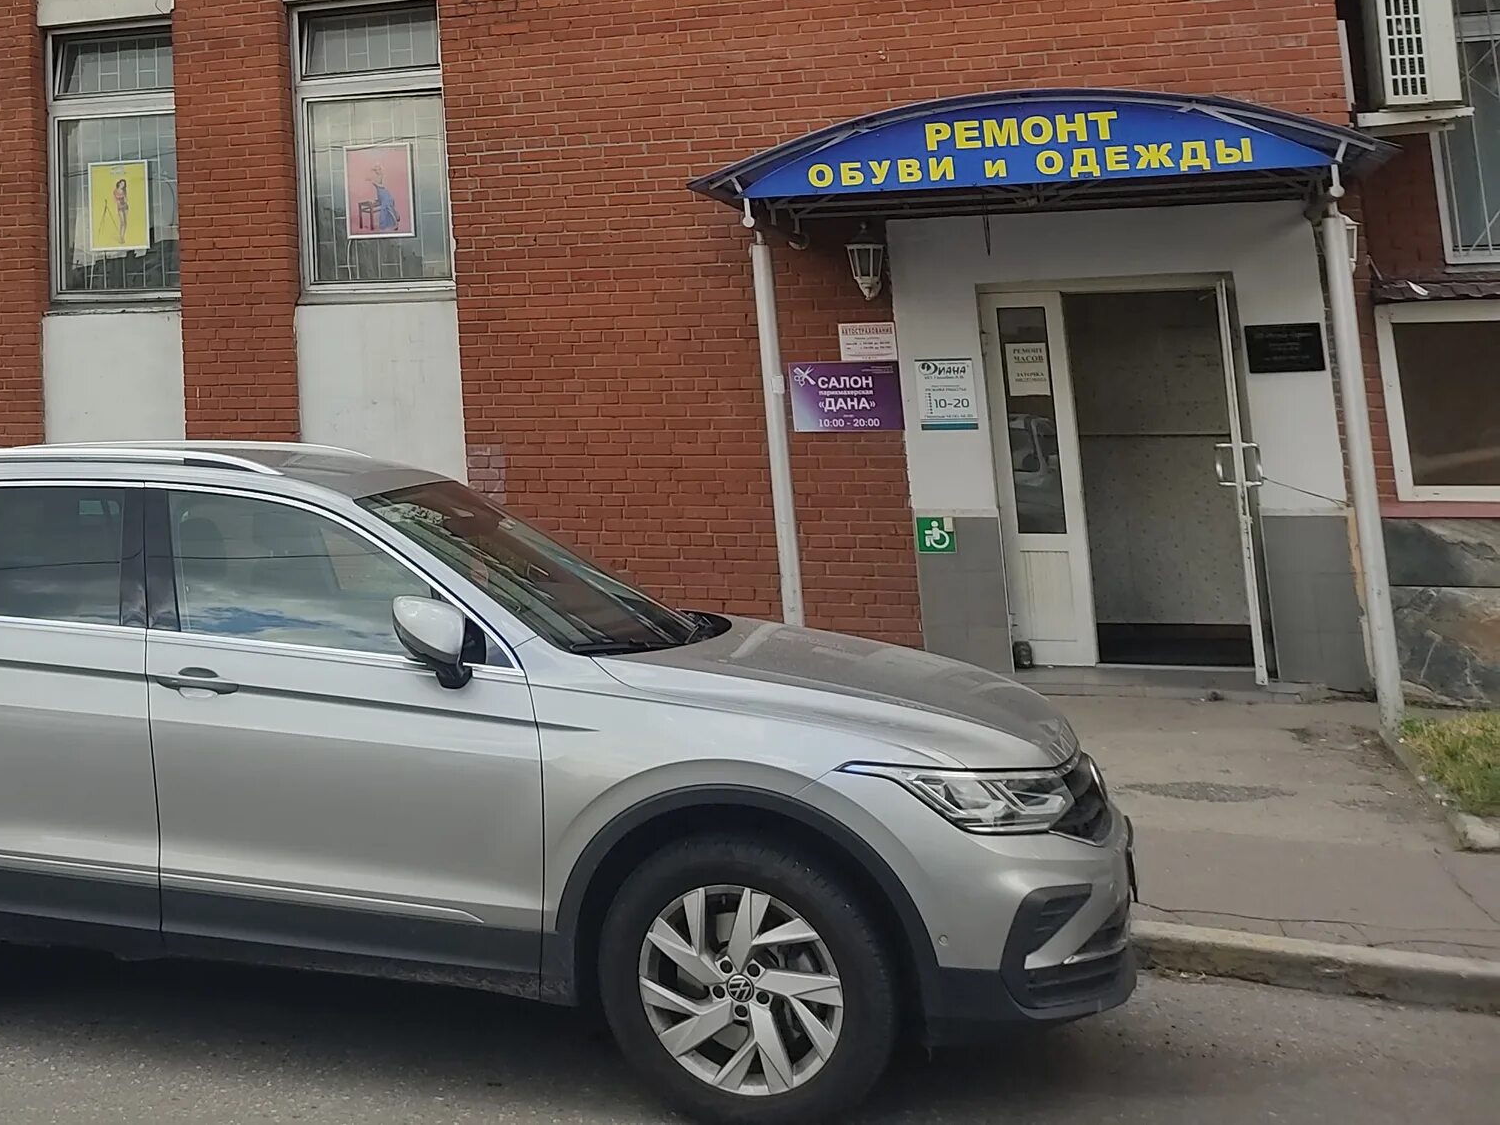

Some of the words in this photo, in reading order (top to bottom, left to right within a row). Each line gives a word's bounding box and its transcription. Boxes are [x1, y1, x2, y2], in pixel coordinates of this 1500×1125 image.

[924, 110, 1118, 152] РЕМОНТ
[807, 156, 956, 188] ОБУВИ
[1036, 137, 1255, 178] ОДЕЖДЫ
[817, 376, 873, 390] САЛОН
[818, 397, 876, 413] «ДАНА»
[933, 397, 970, 409] 10-20
[819, 418, 845, 428] 10:00
[853, 418, 881, 428] 20:00
